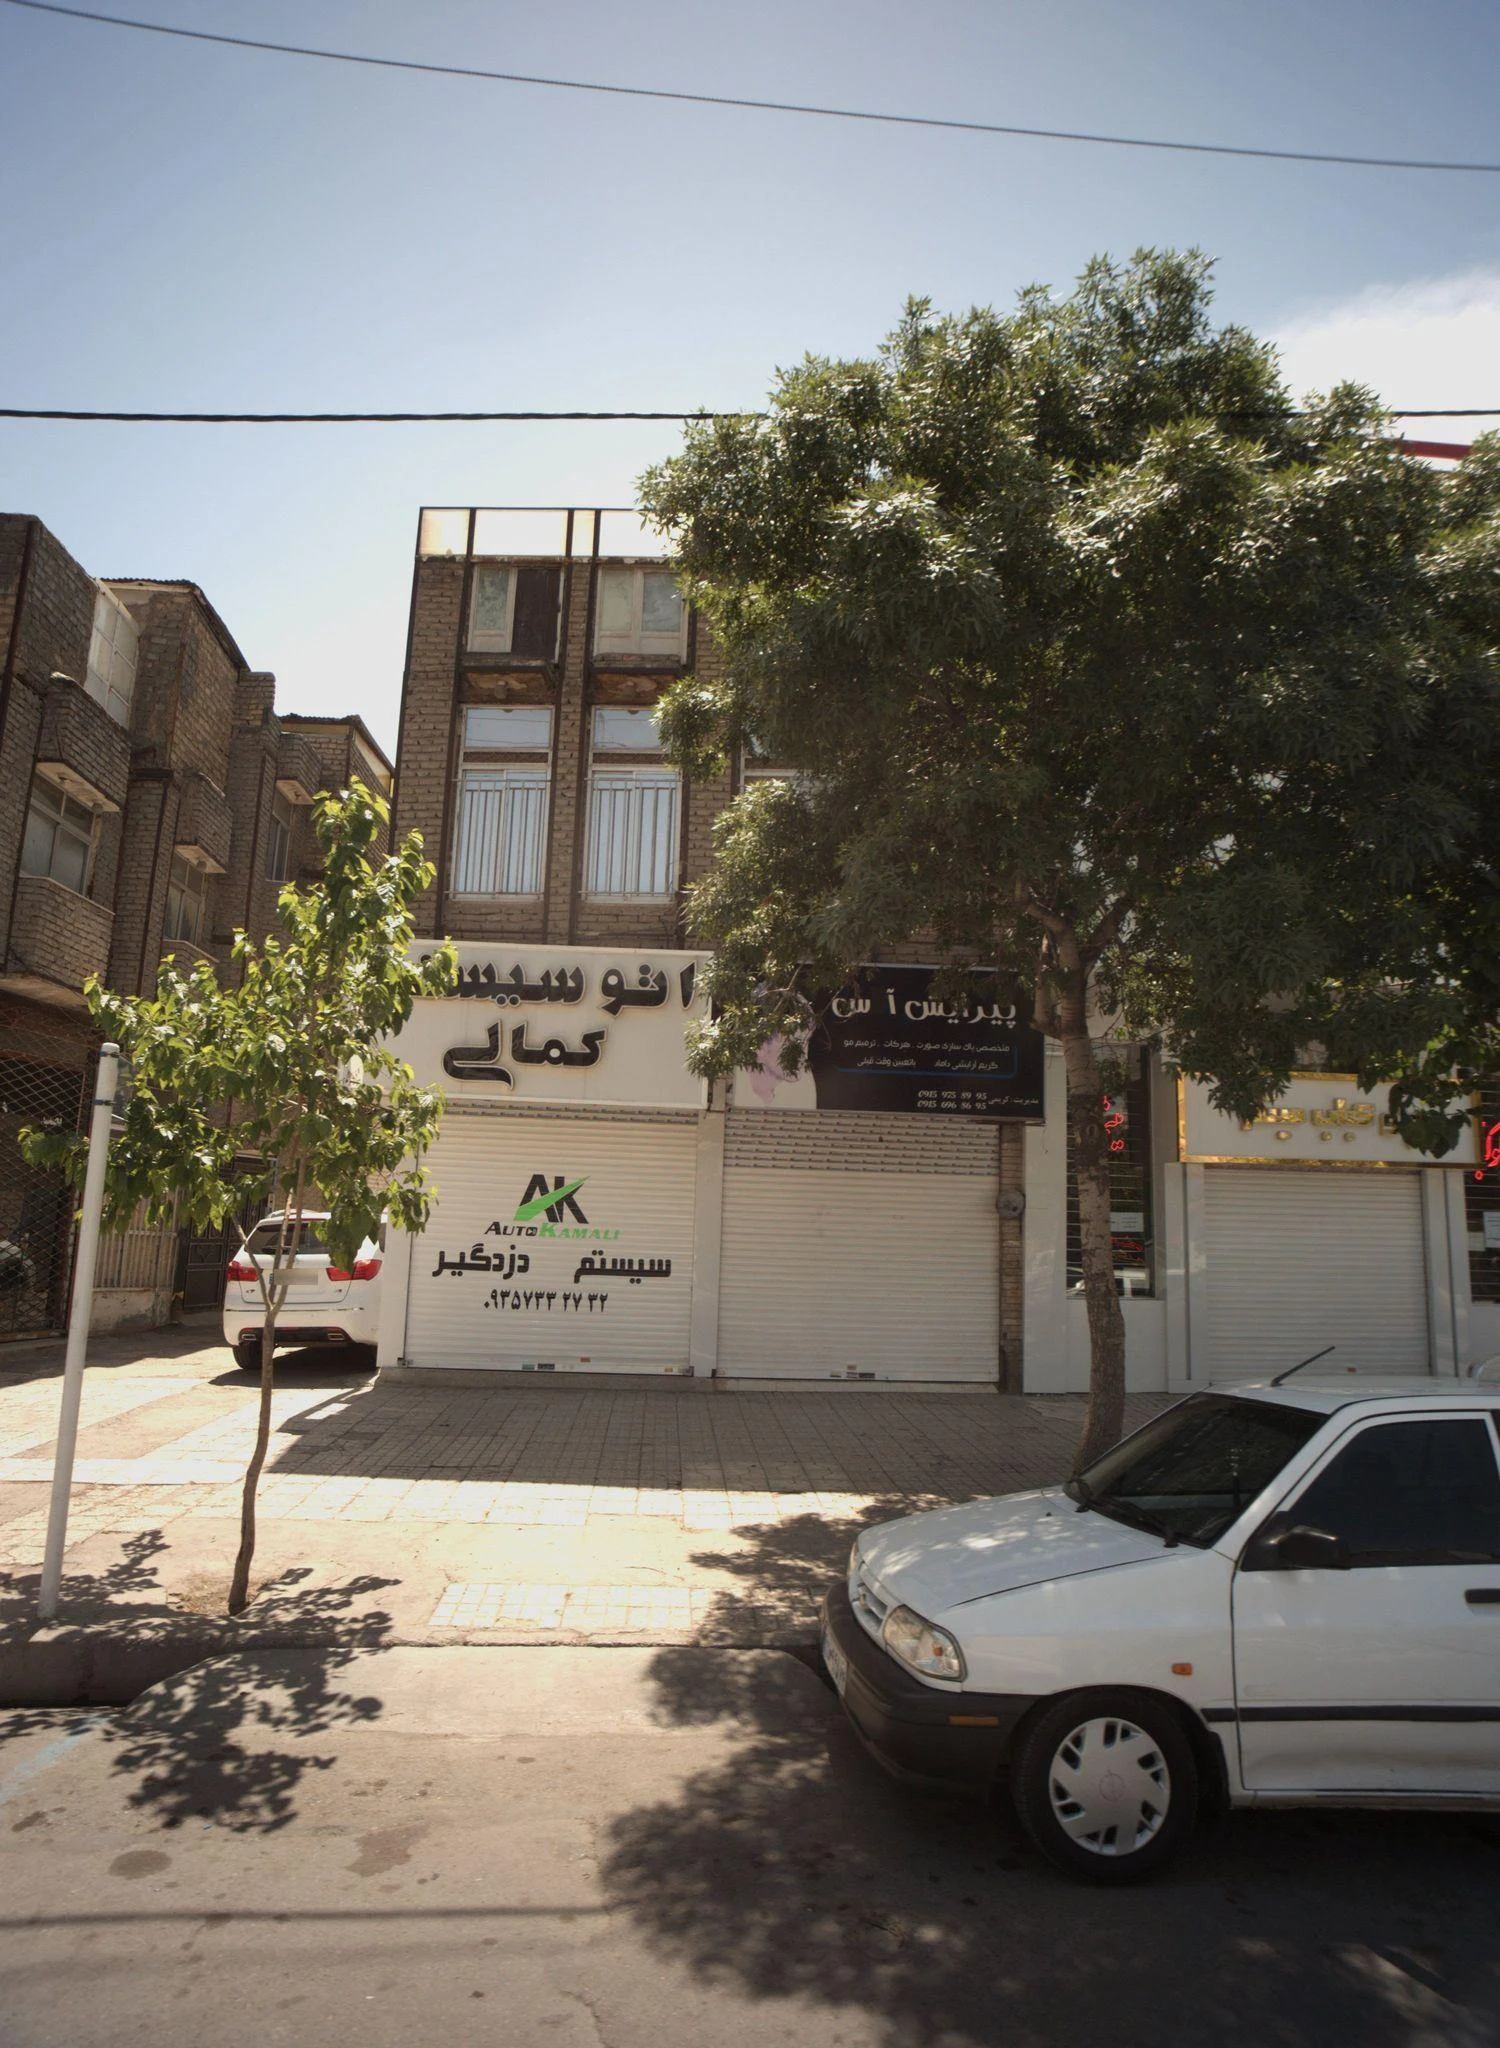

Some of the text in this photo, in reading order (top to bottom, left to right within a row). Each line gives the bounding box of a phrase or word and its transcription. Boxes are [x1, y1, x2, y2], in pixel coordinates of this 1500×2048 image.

[413, 954, 697, 1017] اتو سیس
[442, 1019, 608, 1091] کمالی
[514, 1173, 591, 1225] AK
[431, 1242, 672, 1285] سیستم دزدگیر
